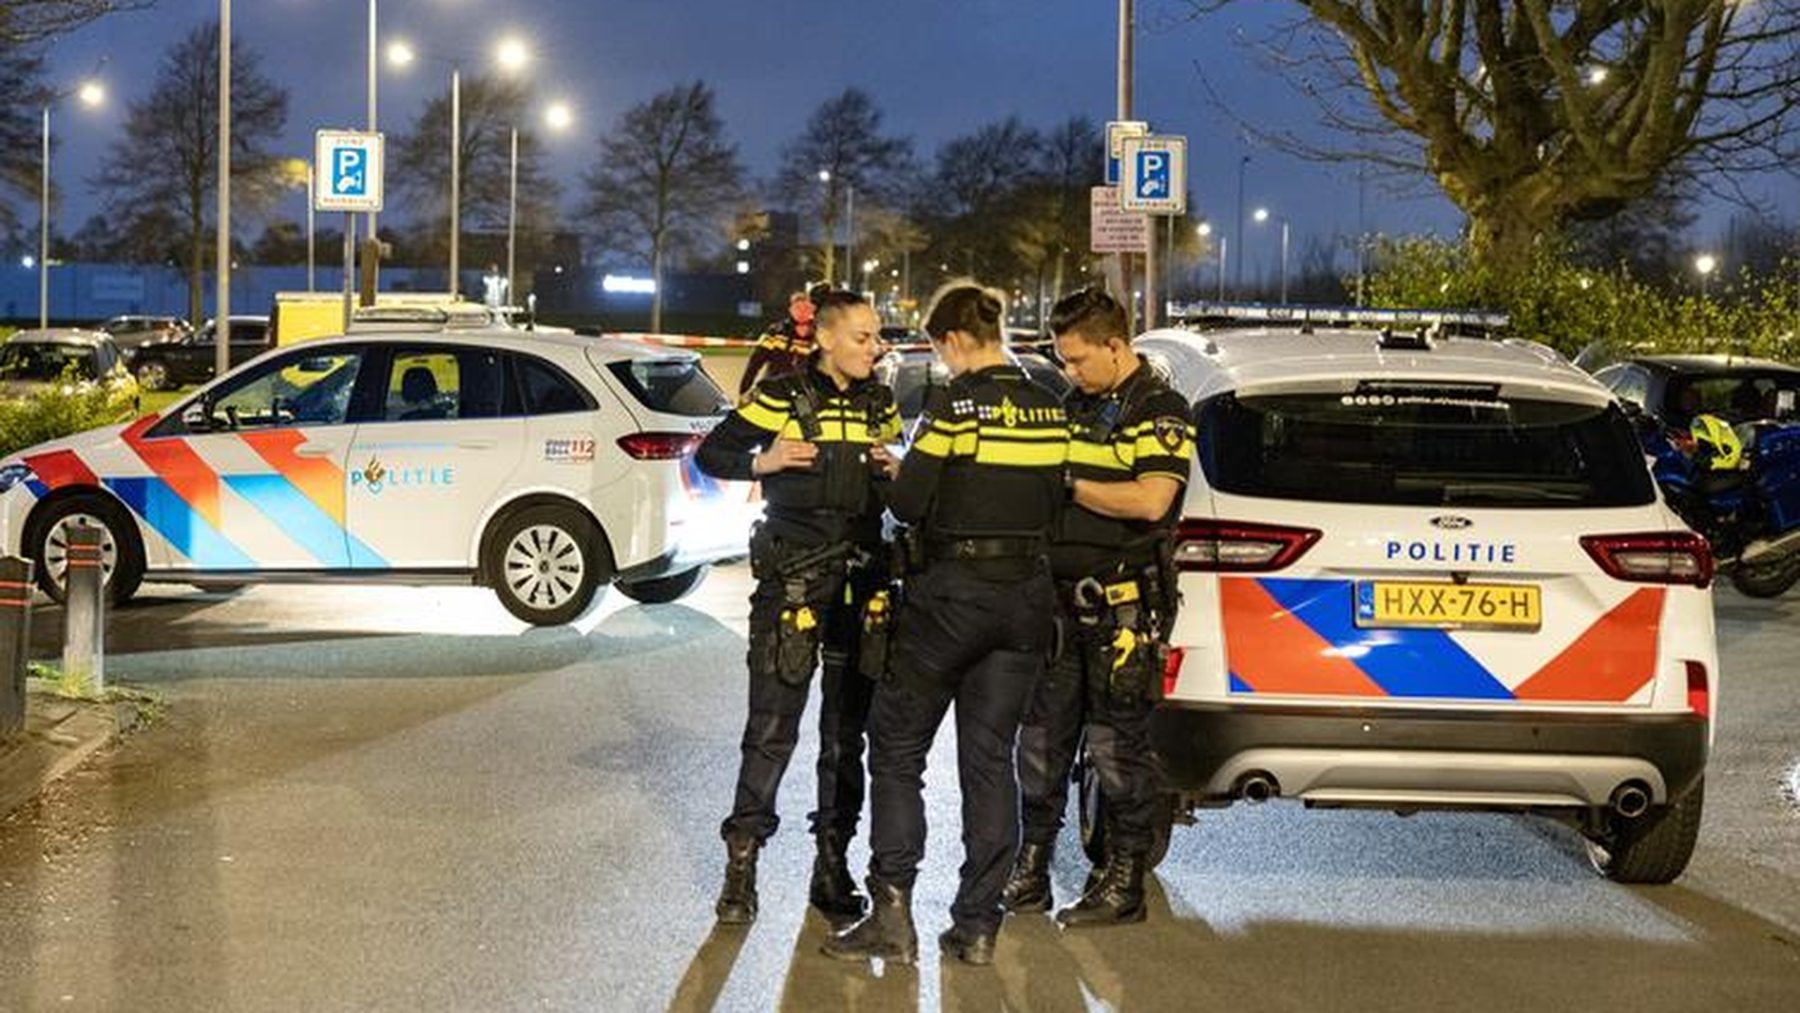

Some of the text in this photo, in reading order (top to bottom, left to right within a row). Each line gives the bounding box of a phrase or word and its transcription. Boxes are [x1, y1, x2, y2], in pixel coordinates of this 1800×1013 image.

[339, 150, 360, 176] P
[1143, 155, 1163, 178] P
[571, 439, 596, 456] 112
[1386, 541, 1516, 563] POLITIE
[1383, 587, 1530, 618] HXX-76-H
